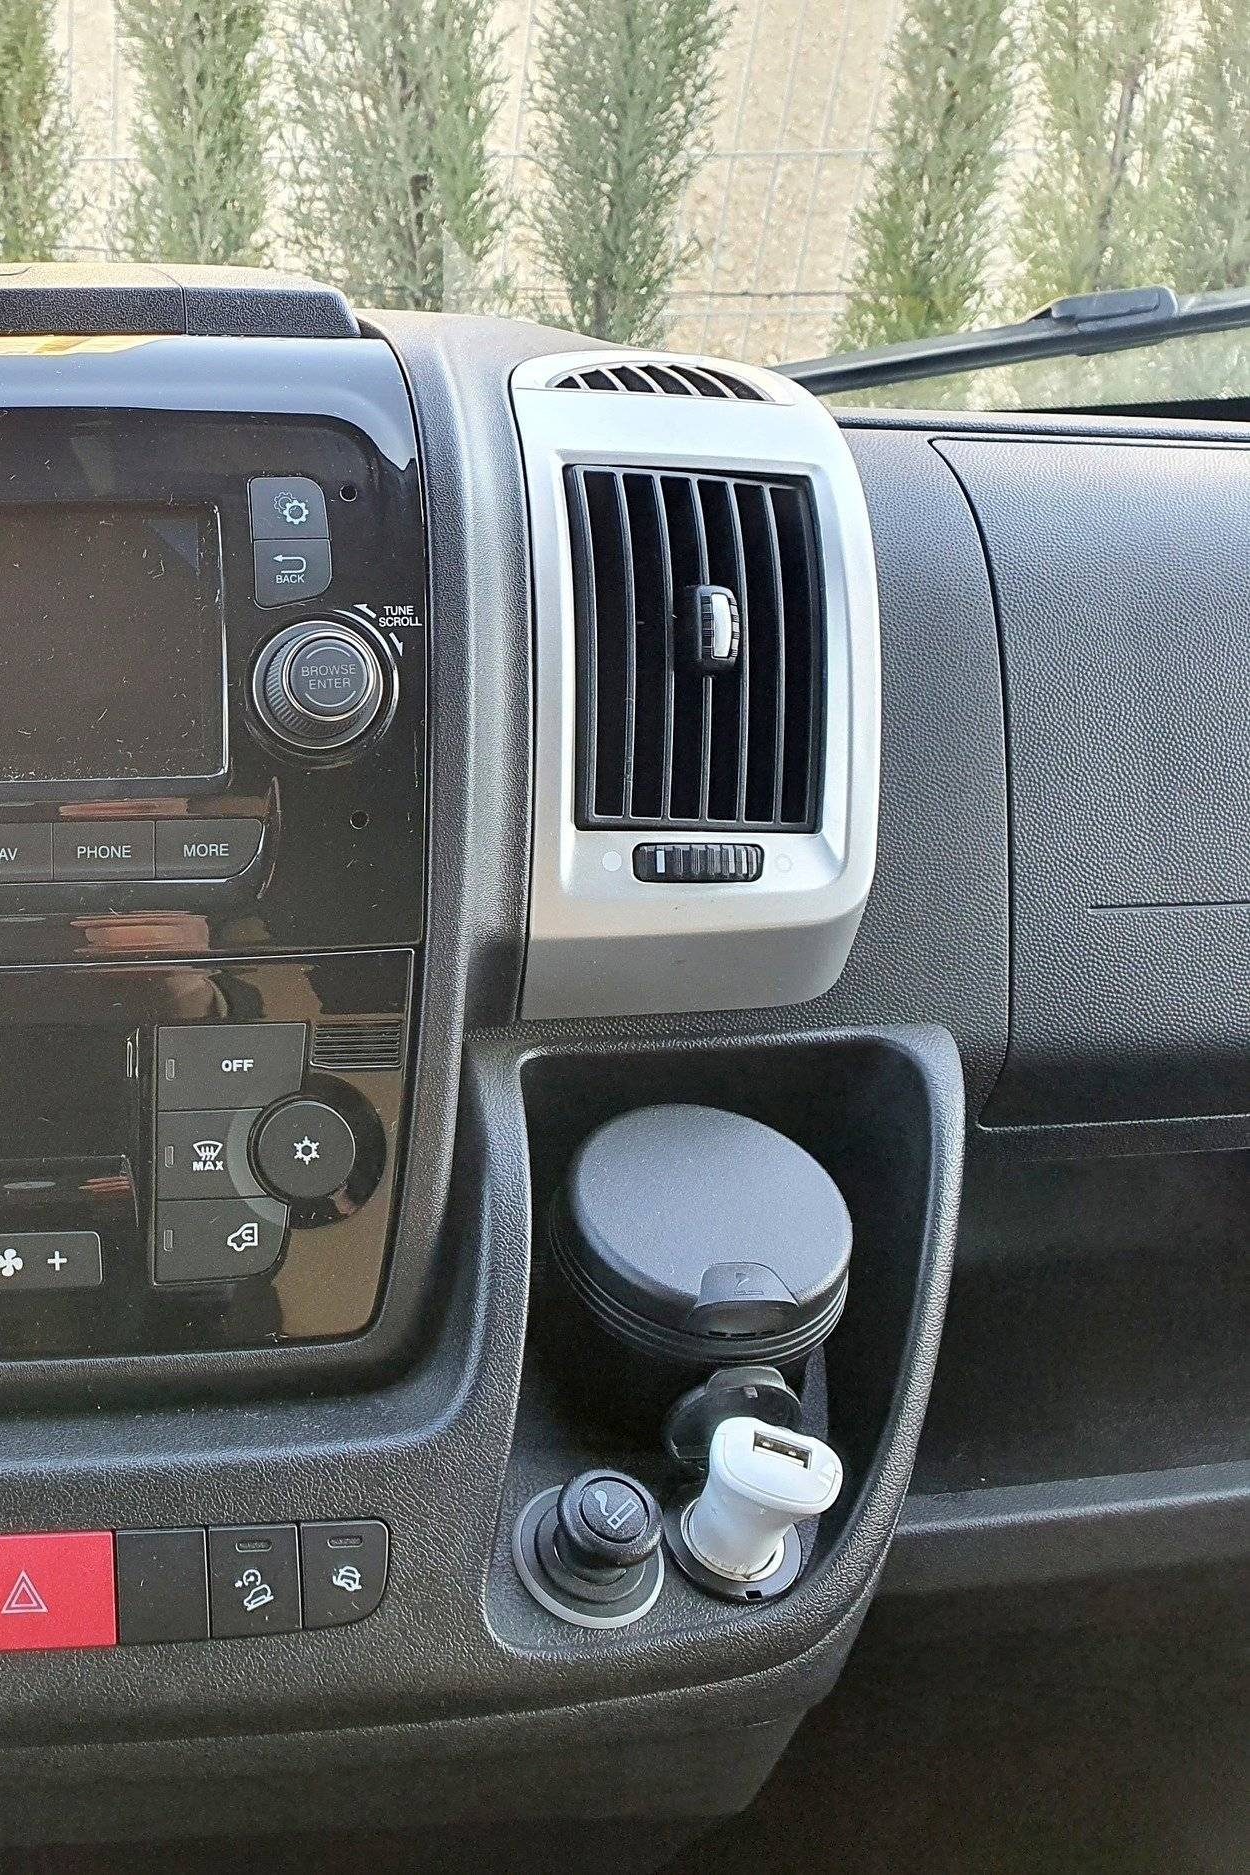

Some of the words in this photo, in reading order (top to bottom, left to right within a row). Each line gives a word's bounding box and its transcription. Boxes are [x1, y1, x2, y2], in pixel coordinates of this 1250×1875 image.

[275, 574, 305, 584] BACK
[383, 605, 414, 616] TUNE
[378, 616, 423, 627] SCROLL
[301, 664, 357, 678] BROWSE
[308, 677, 351, 690] ENTER
[76, 845, 132, 859] PHONE
[183, 843, 230, 857] MORE
[221, 1059, 254, 1072] OFF
[192, 1160, 224, 1172] MAX
